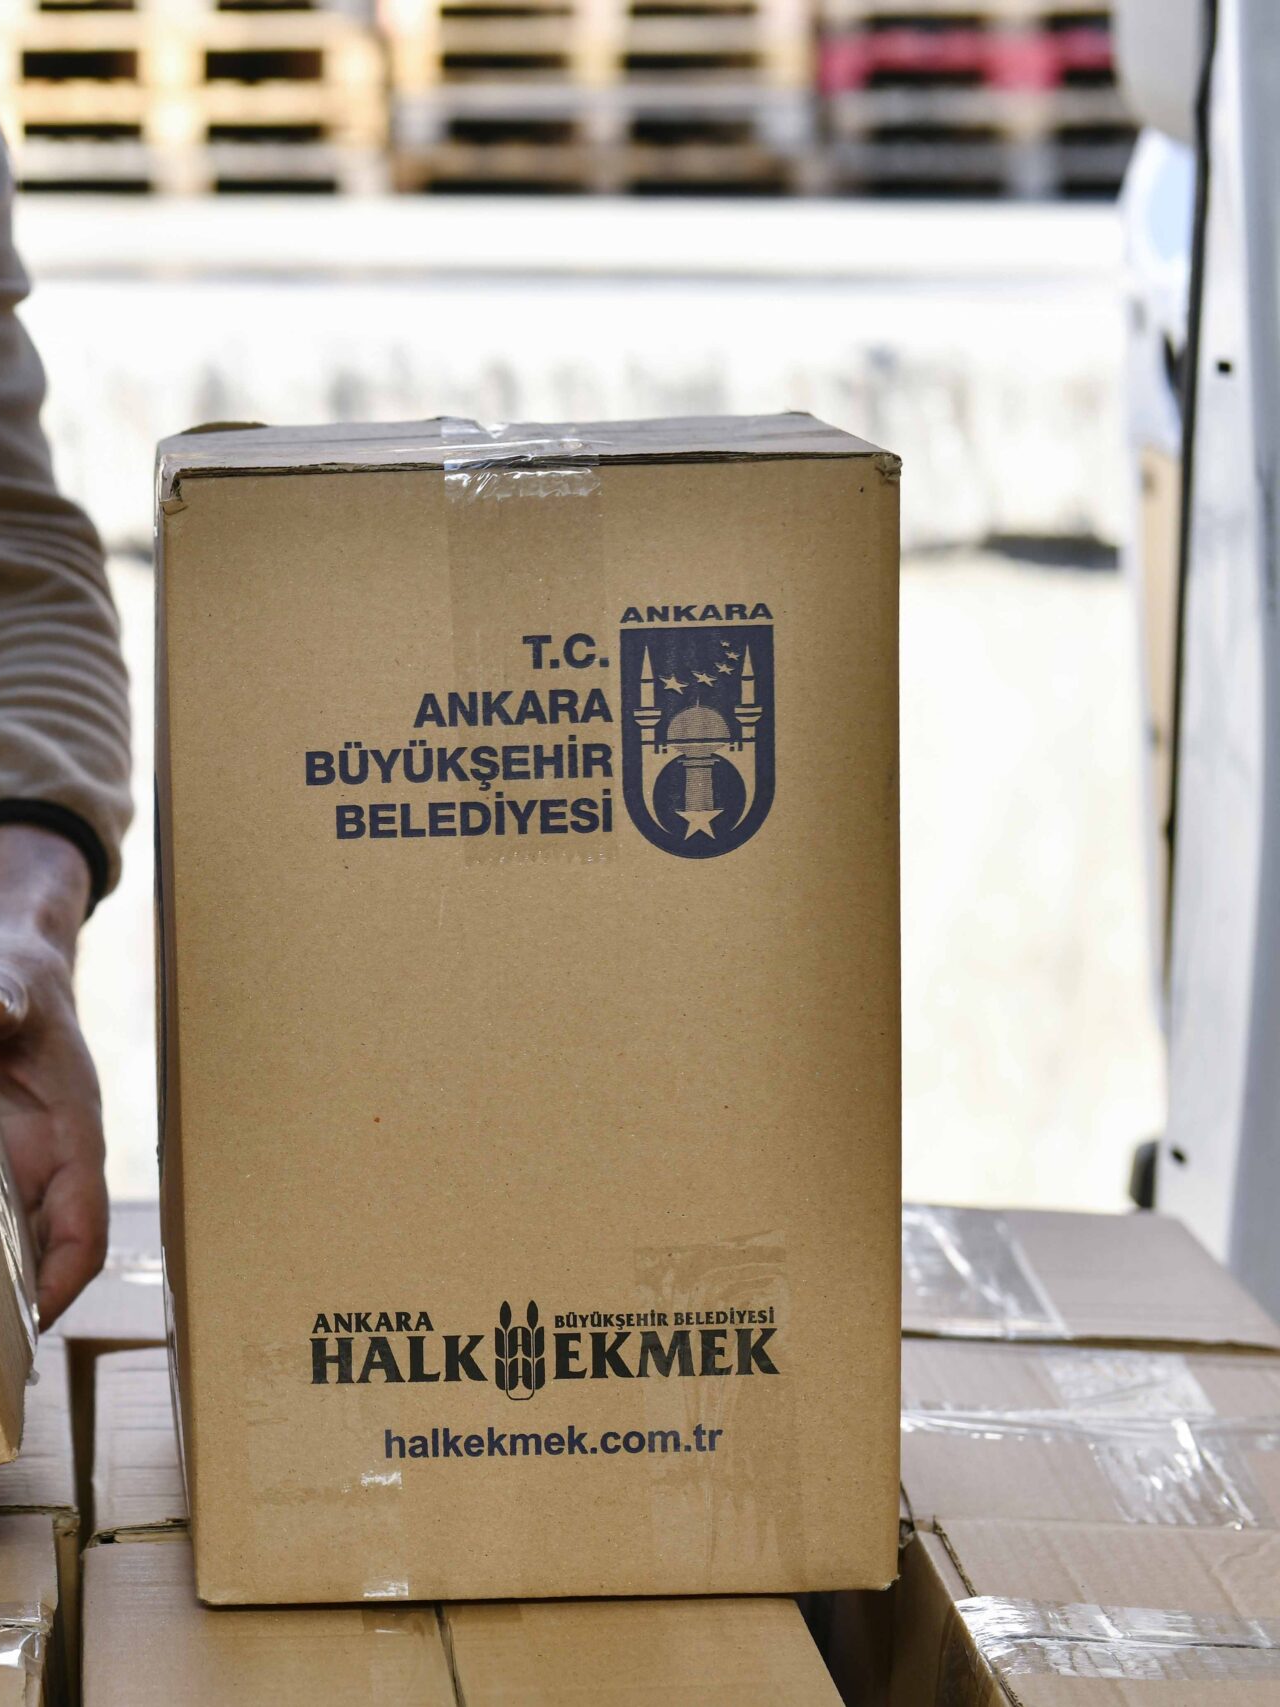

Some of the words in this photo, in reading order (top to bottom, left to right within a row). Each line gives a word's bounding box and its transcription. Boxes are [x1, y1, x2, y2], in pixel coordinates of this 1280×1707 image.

[620, 603, 773, 624] ANKARA
[523, 633, 610, 670] T.C.
[413, 688, 613, 728] ANKARA
[305, 735, 613, 791] BÜYÜKŞEHİR
[336, 789, 613, 839] BELEDİYESİ
[311, 1311, 435, 1334] ANKARA
[555, 1309, 668, 1330] BÜYÜKŞEHİR
[674, 1306, 775, 1326] BELEDİYESİ
[310, 1334, 488, 1385] HALK
[553, 1328, 781, 1380] EKMEK
[385, 1423, 723, 1459] halkekmek.com.tr
